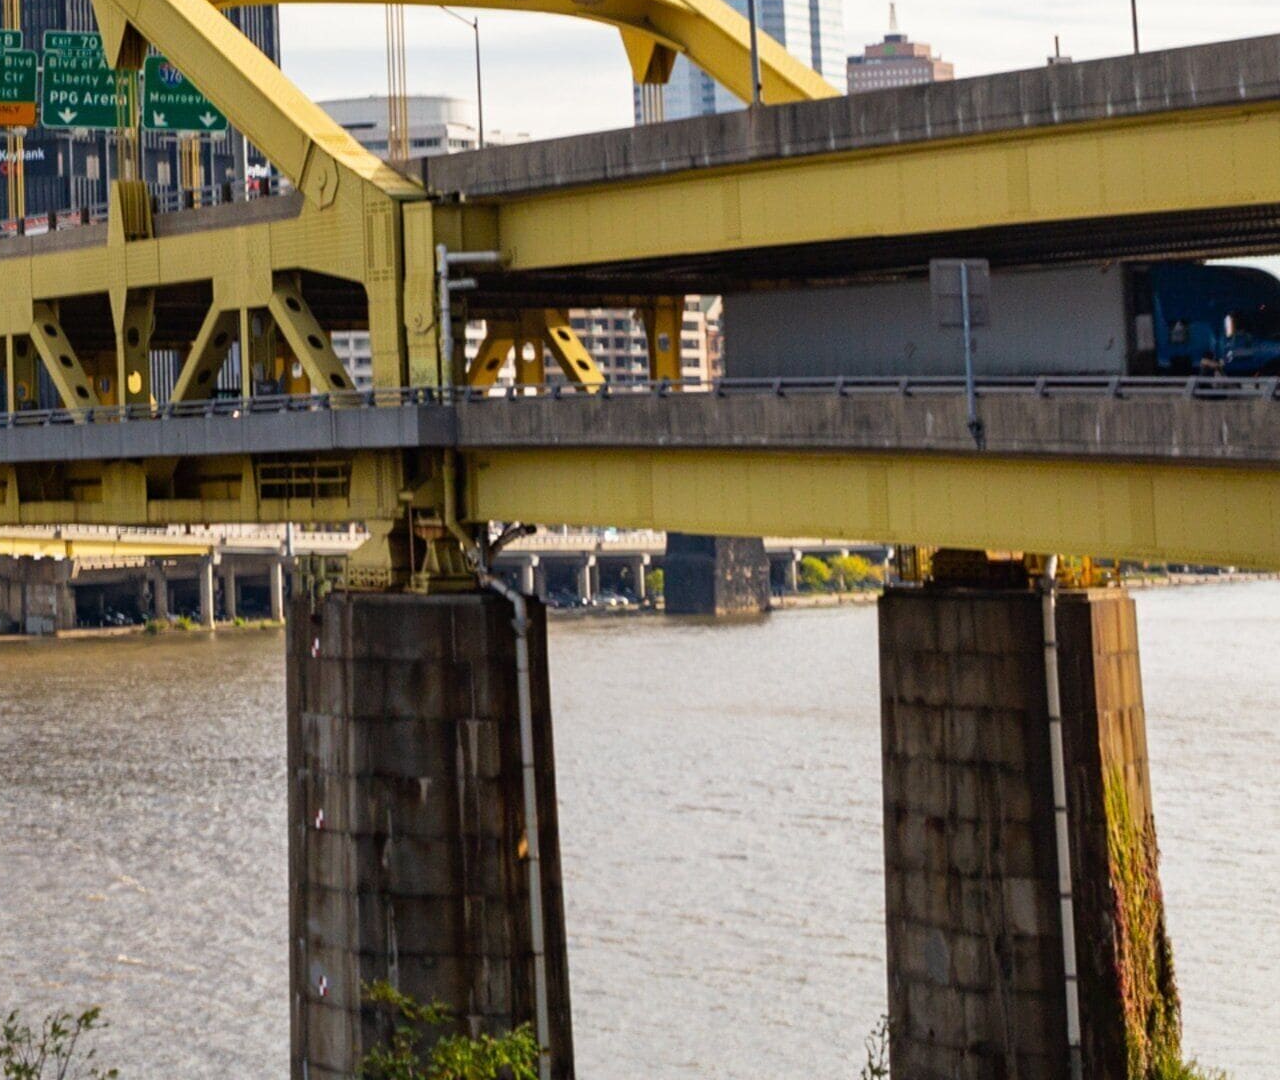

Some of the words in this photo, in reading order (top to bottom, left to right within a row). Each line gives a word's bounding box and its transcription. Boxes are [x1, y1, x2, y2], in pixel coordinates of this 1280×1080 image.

[52, 36, 72, 46] EXIT
[4, 56, 33, 68] Blvd
[49, 57, 77, 68] Blvd
[81, 58, 93, 68] of
[4, 71, 24, 83] Ctr
[53, 73, 99, 87] Liberty
[50, 90, 78, 105] PPG
[83, 91, 127, 106] Arena
